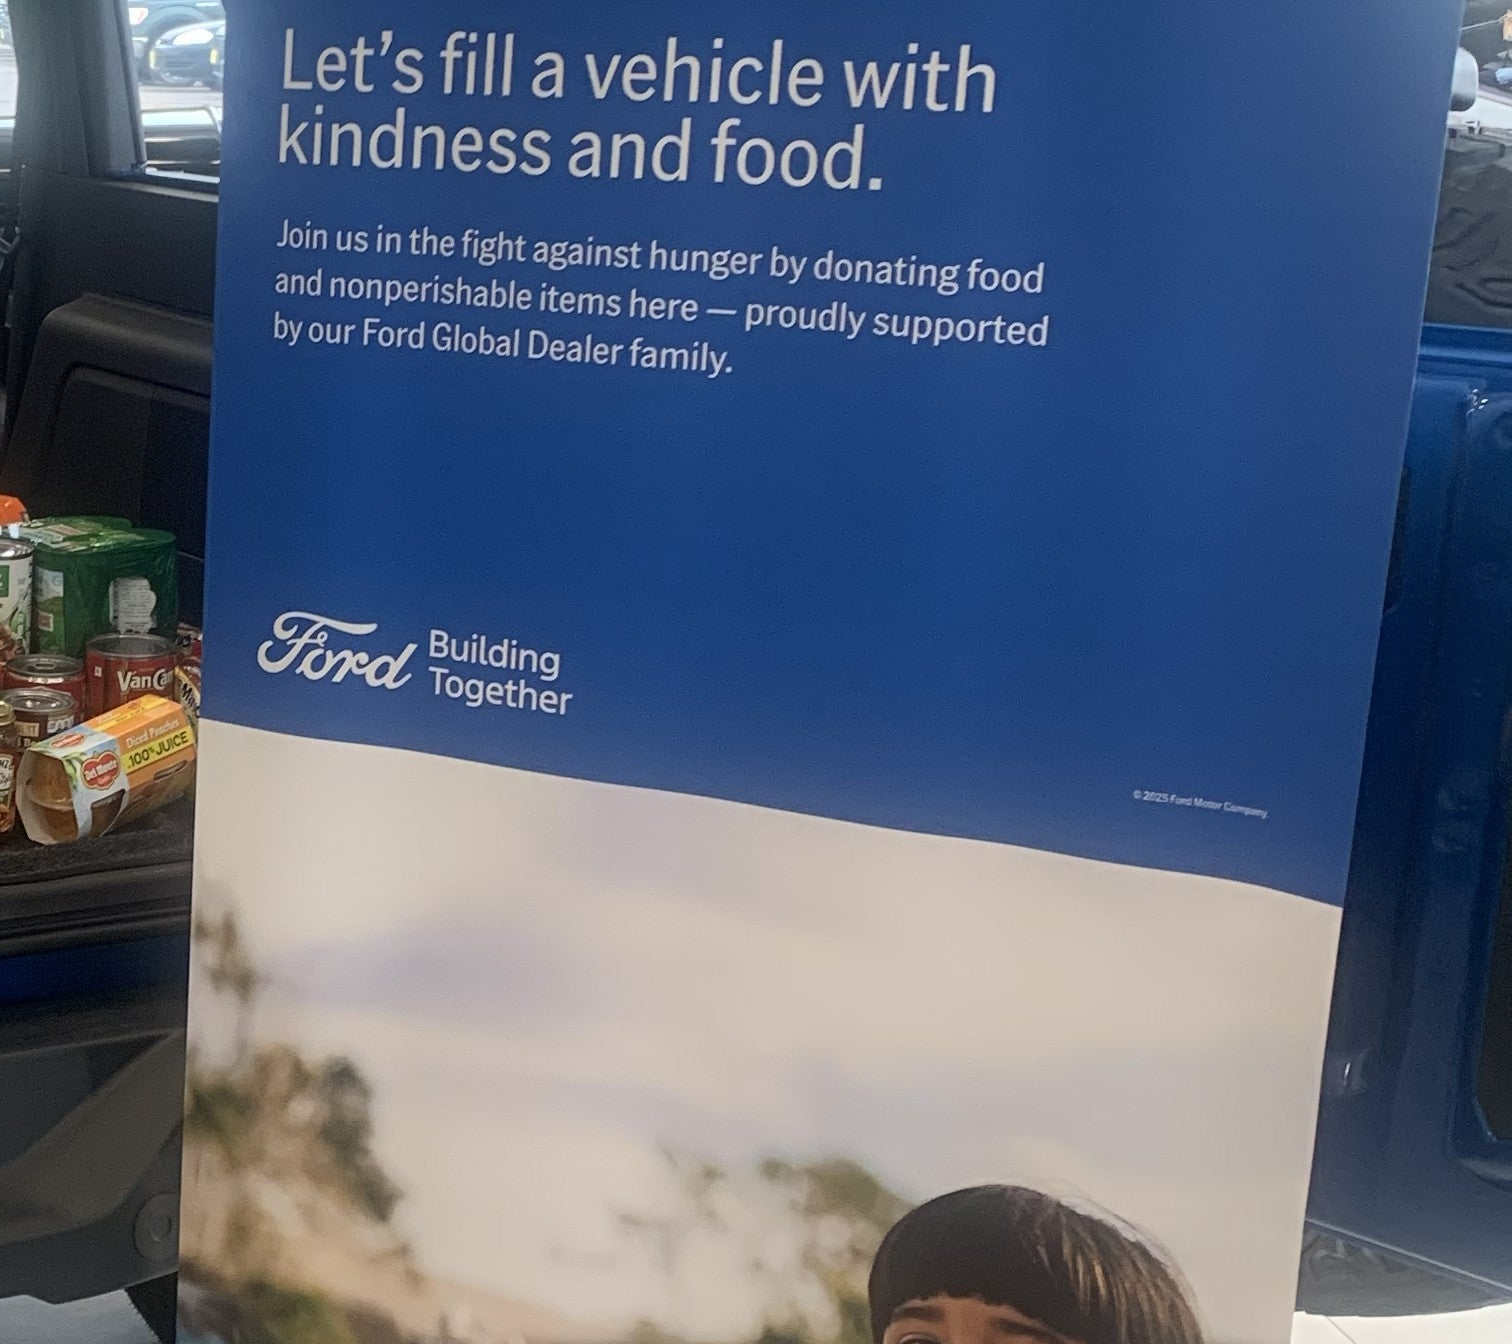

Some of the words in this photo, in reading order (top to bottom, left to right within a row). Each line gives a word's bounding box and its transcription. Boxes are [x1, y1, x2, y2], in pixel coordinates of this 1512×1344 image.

[283, 28, 425, 94] Let's
[440, 30, 515, 96] fill
[532, 52, 565, 99] a
[585, 37, 825, 108] vehicle
[843, 43, 997, 113] with
[278, 102, 552, 176] kindness
[568, 117, 692, 182] and
[710, 117, 883, 191] food.
[276, 219, 328, 251] Join
[336, 228, 369, 253] us
[376, 224, 402, 254] in
[409, 226, 455, 257] the
[462, 228, 526, 266] fight
[532, 236, 642, 271] against
[649, 239, 763, 281] hunger
[770, 246, 807, 284] by
[813, 250, 961, 295] donating
[967, 258, 1045, 294] food
[273, 311, 303, 346] by
[308, 320, 356, 346] our
[362, 317, 425, 350] Ford
[432, 321, 520, 356] Global
[528, 329, 624, 365] Dealer
[629, 336, 733, 379] family.
[274, 268, 322, 297] and
[329, 274, 532, 311] nonperishable
[539, 282, 621, 316] items
[872, 311, 1050, 347] supported
[257, 611, 418, 690] Ford
[429, 629, 561, 681] Building
[428, 666, 574, 716] Together
[155, 731, 189, 757] JUICE
[1223, 801, 1270, 819] Company
